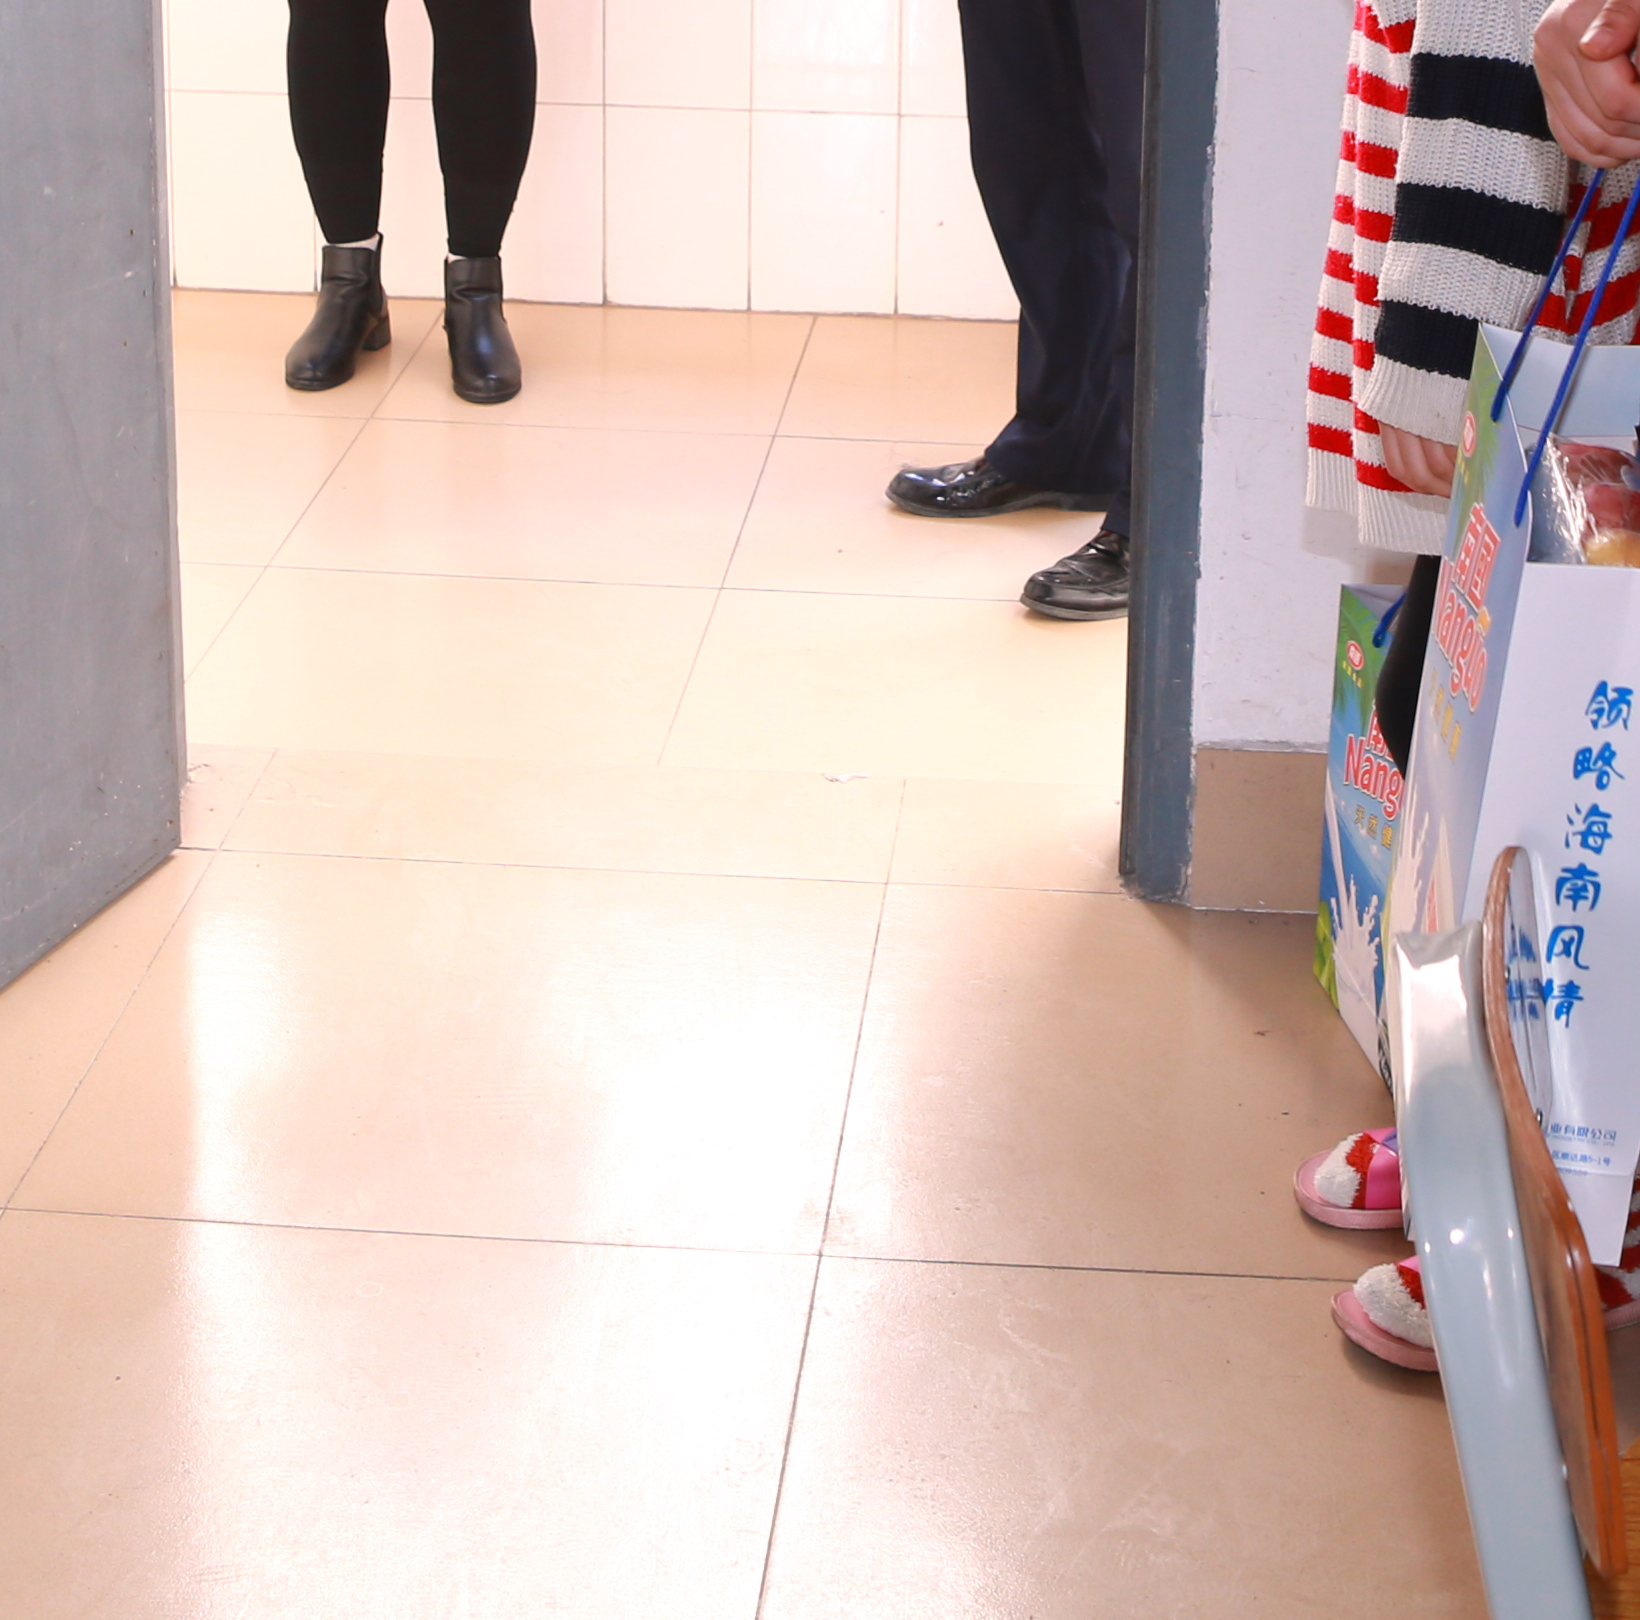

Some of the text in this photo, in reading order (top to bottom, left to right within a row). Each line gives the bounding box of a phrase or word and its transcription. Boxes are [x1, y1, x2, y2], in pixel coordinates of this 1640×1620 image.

[1343, 733, 1405, 821] Nang
[1541, 679, 1634, 1029] 领略海南风情
